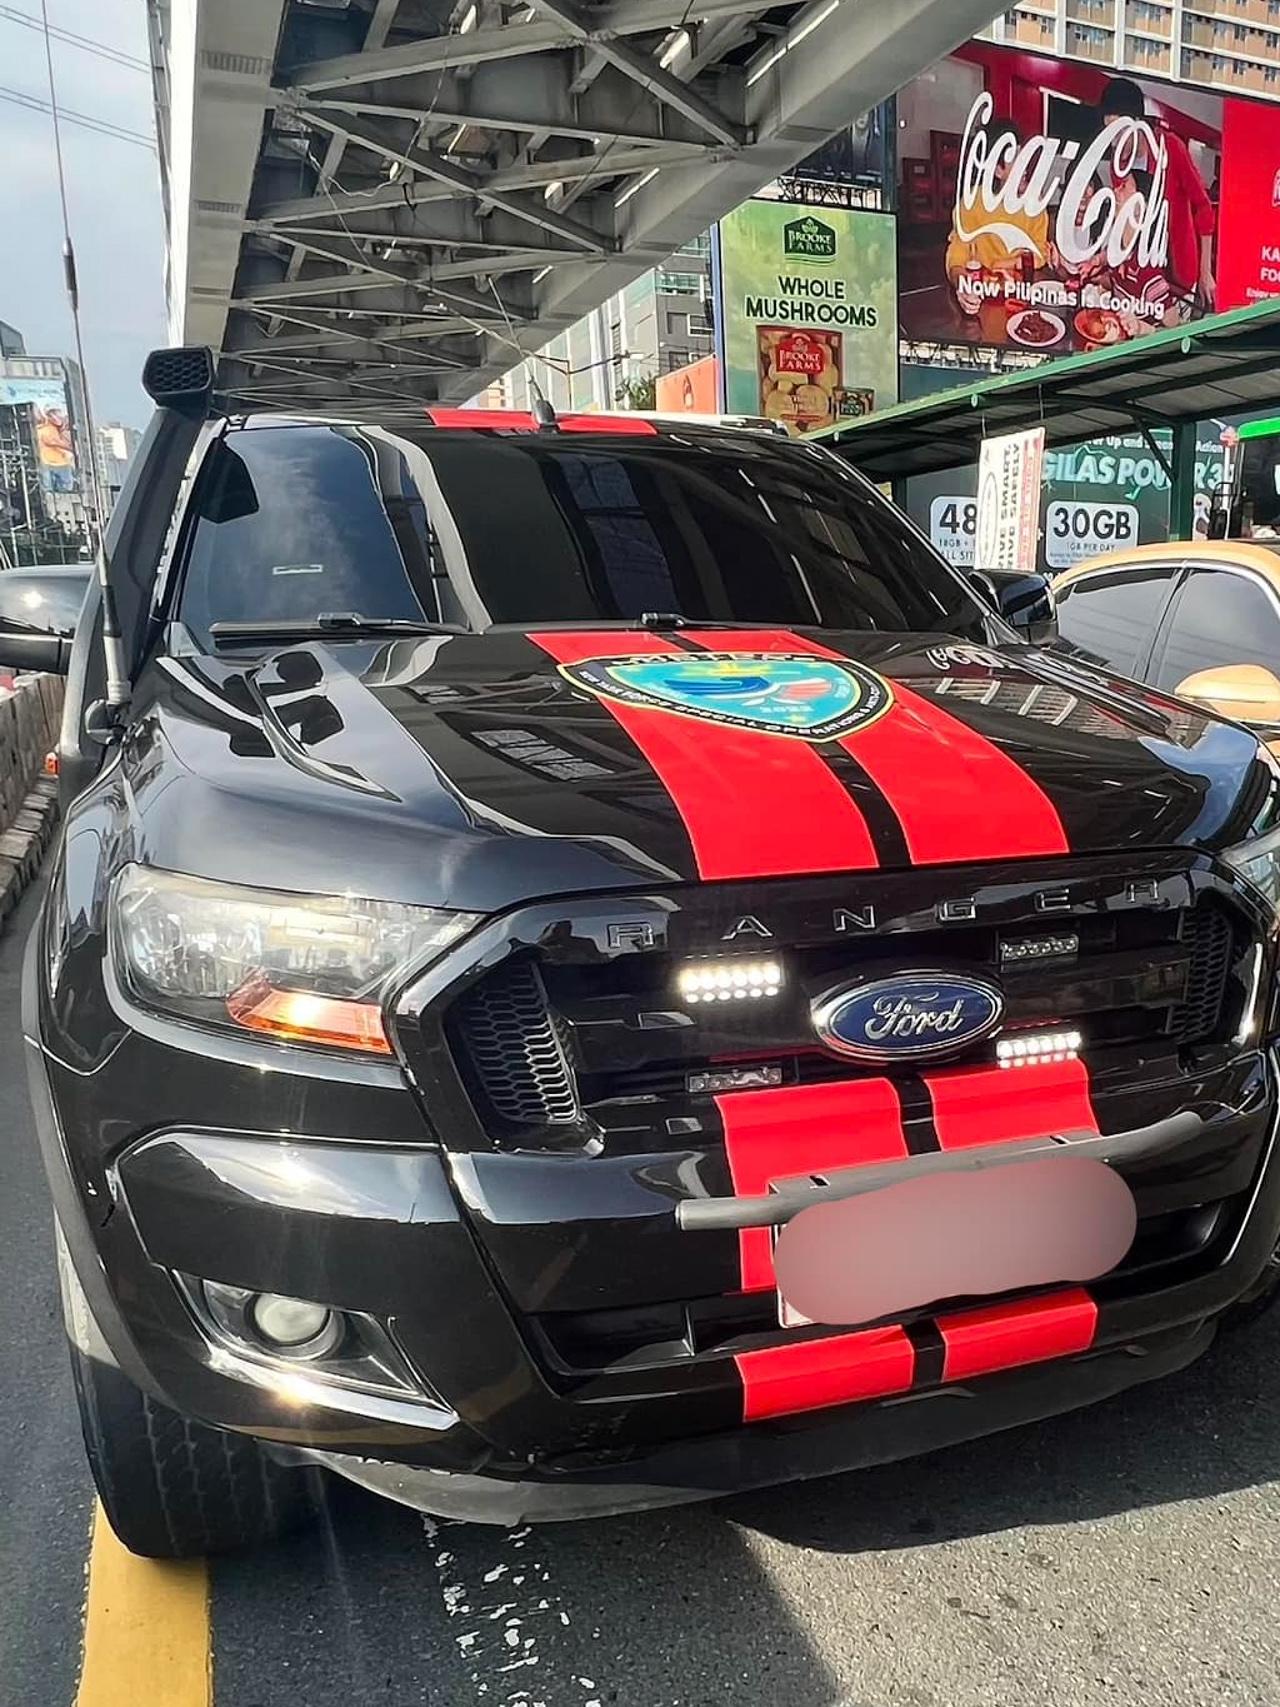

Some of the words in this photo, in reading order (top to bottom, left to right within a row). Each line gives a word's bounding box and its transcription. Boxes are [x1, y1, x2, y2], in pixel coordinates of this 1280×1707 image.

[956, 91, 1169, 268] Coca-Cola
[778, 275, 845, 300] WHOLE
[958, 275, 1001, 299] Now
[1004, 277, 1077, 307] Pilipinas
[1099, 290, 1165, 320] Cooking
[746, 297, 877, 327] MUSHROOMS
[1053, 507, 1132, 540] 30GB
[607, 878, 1161, 950] RANGER
[865, 991, 965, 1041] Ford
